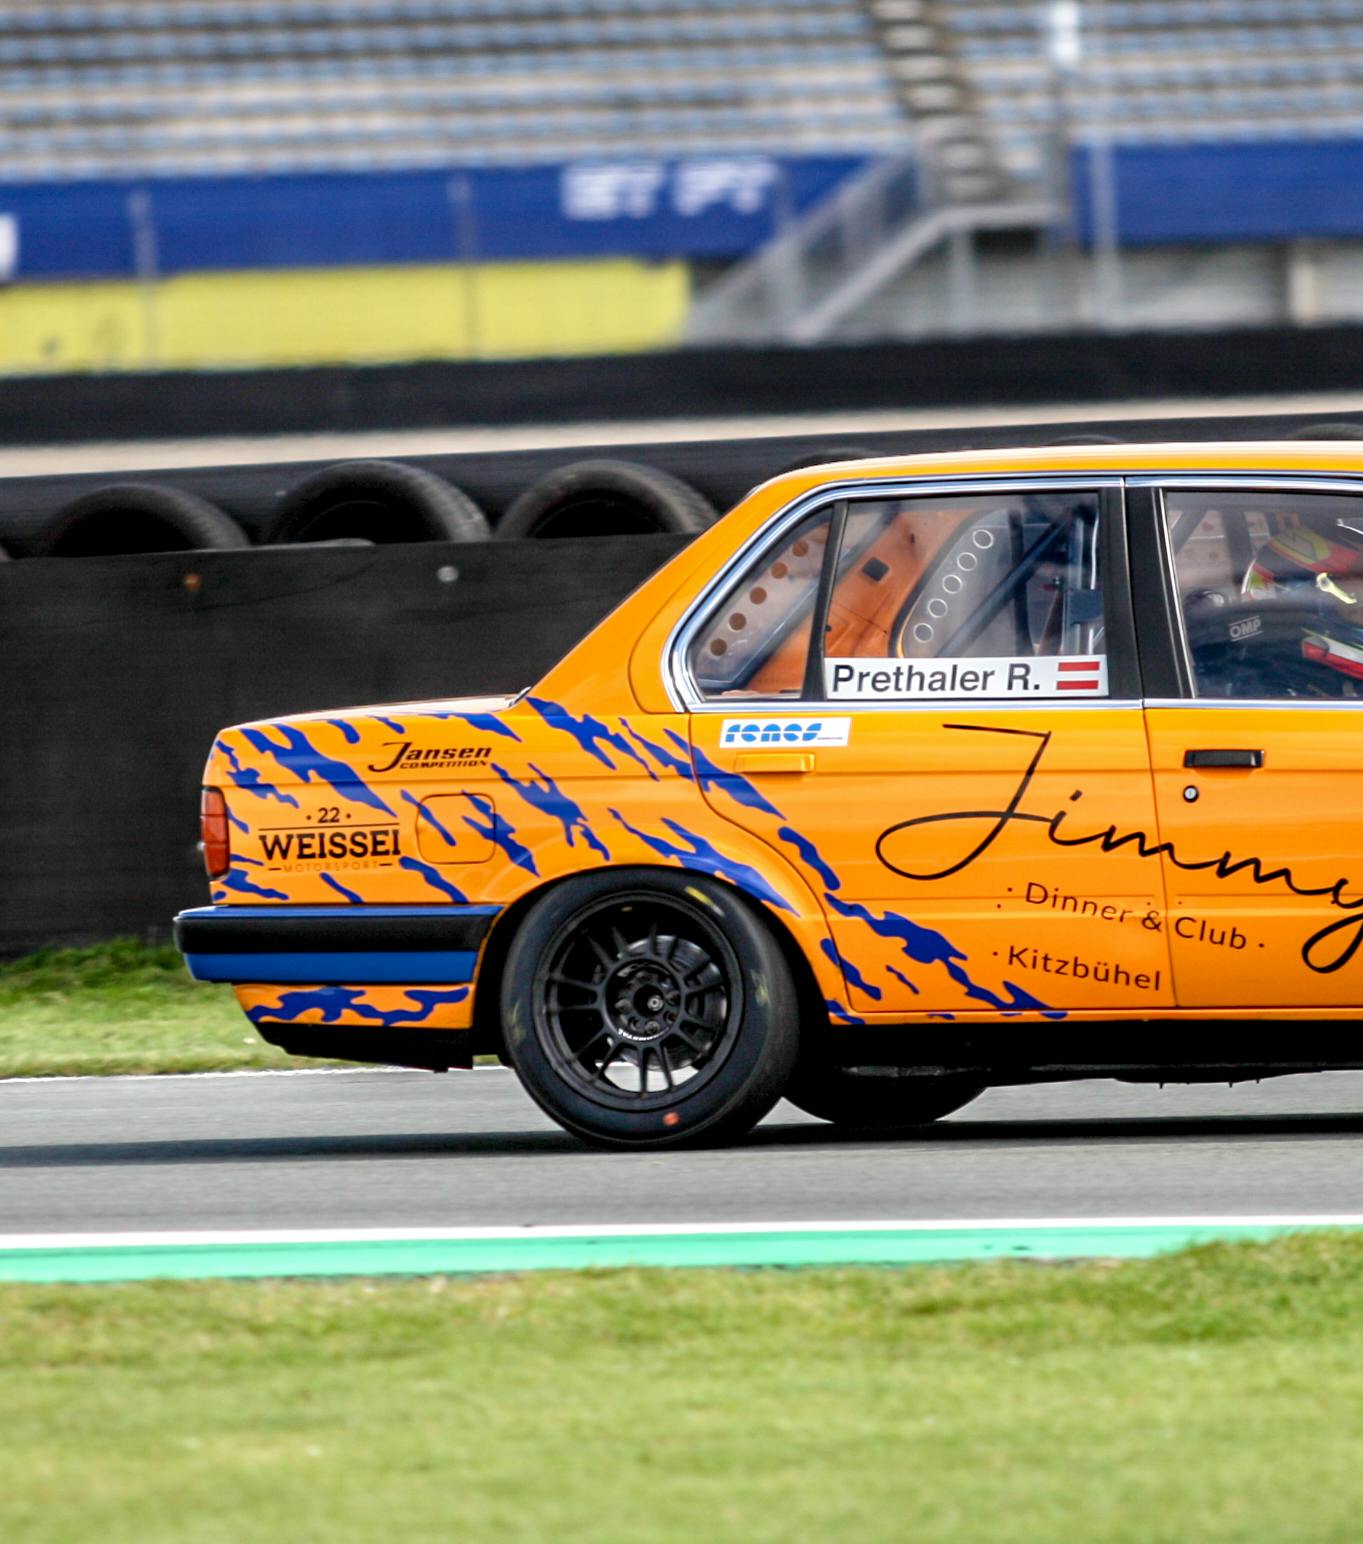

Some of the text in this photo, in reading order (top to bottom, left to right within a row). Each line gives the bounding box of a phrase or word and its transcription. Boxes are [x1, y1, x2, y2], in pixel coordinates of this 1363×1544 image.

[1229, 618, 1262, 638] OMP
[832, 663, 1040, 693] Prethaler R.
[368, 742, 492, 773] Jansen
[400, 760, 488, 770] COMPETITION
[317, 807, 340, 824] 22
[258, 829, 402, 860] WEISSEI
[283, 861, 378, 873] MOTORSPORT
[1025, 882, 1247, 950] Dinner & Club
[1008, 945, 1161, 991] Kitzbühel
